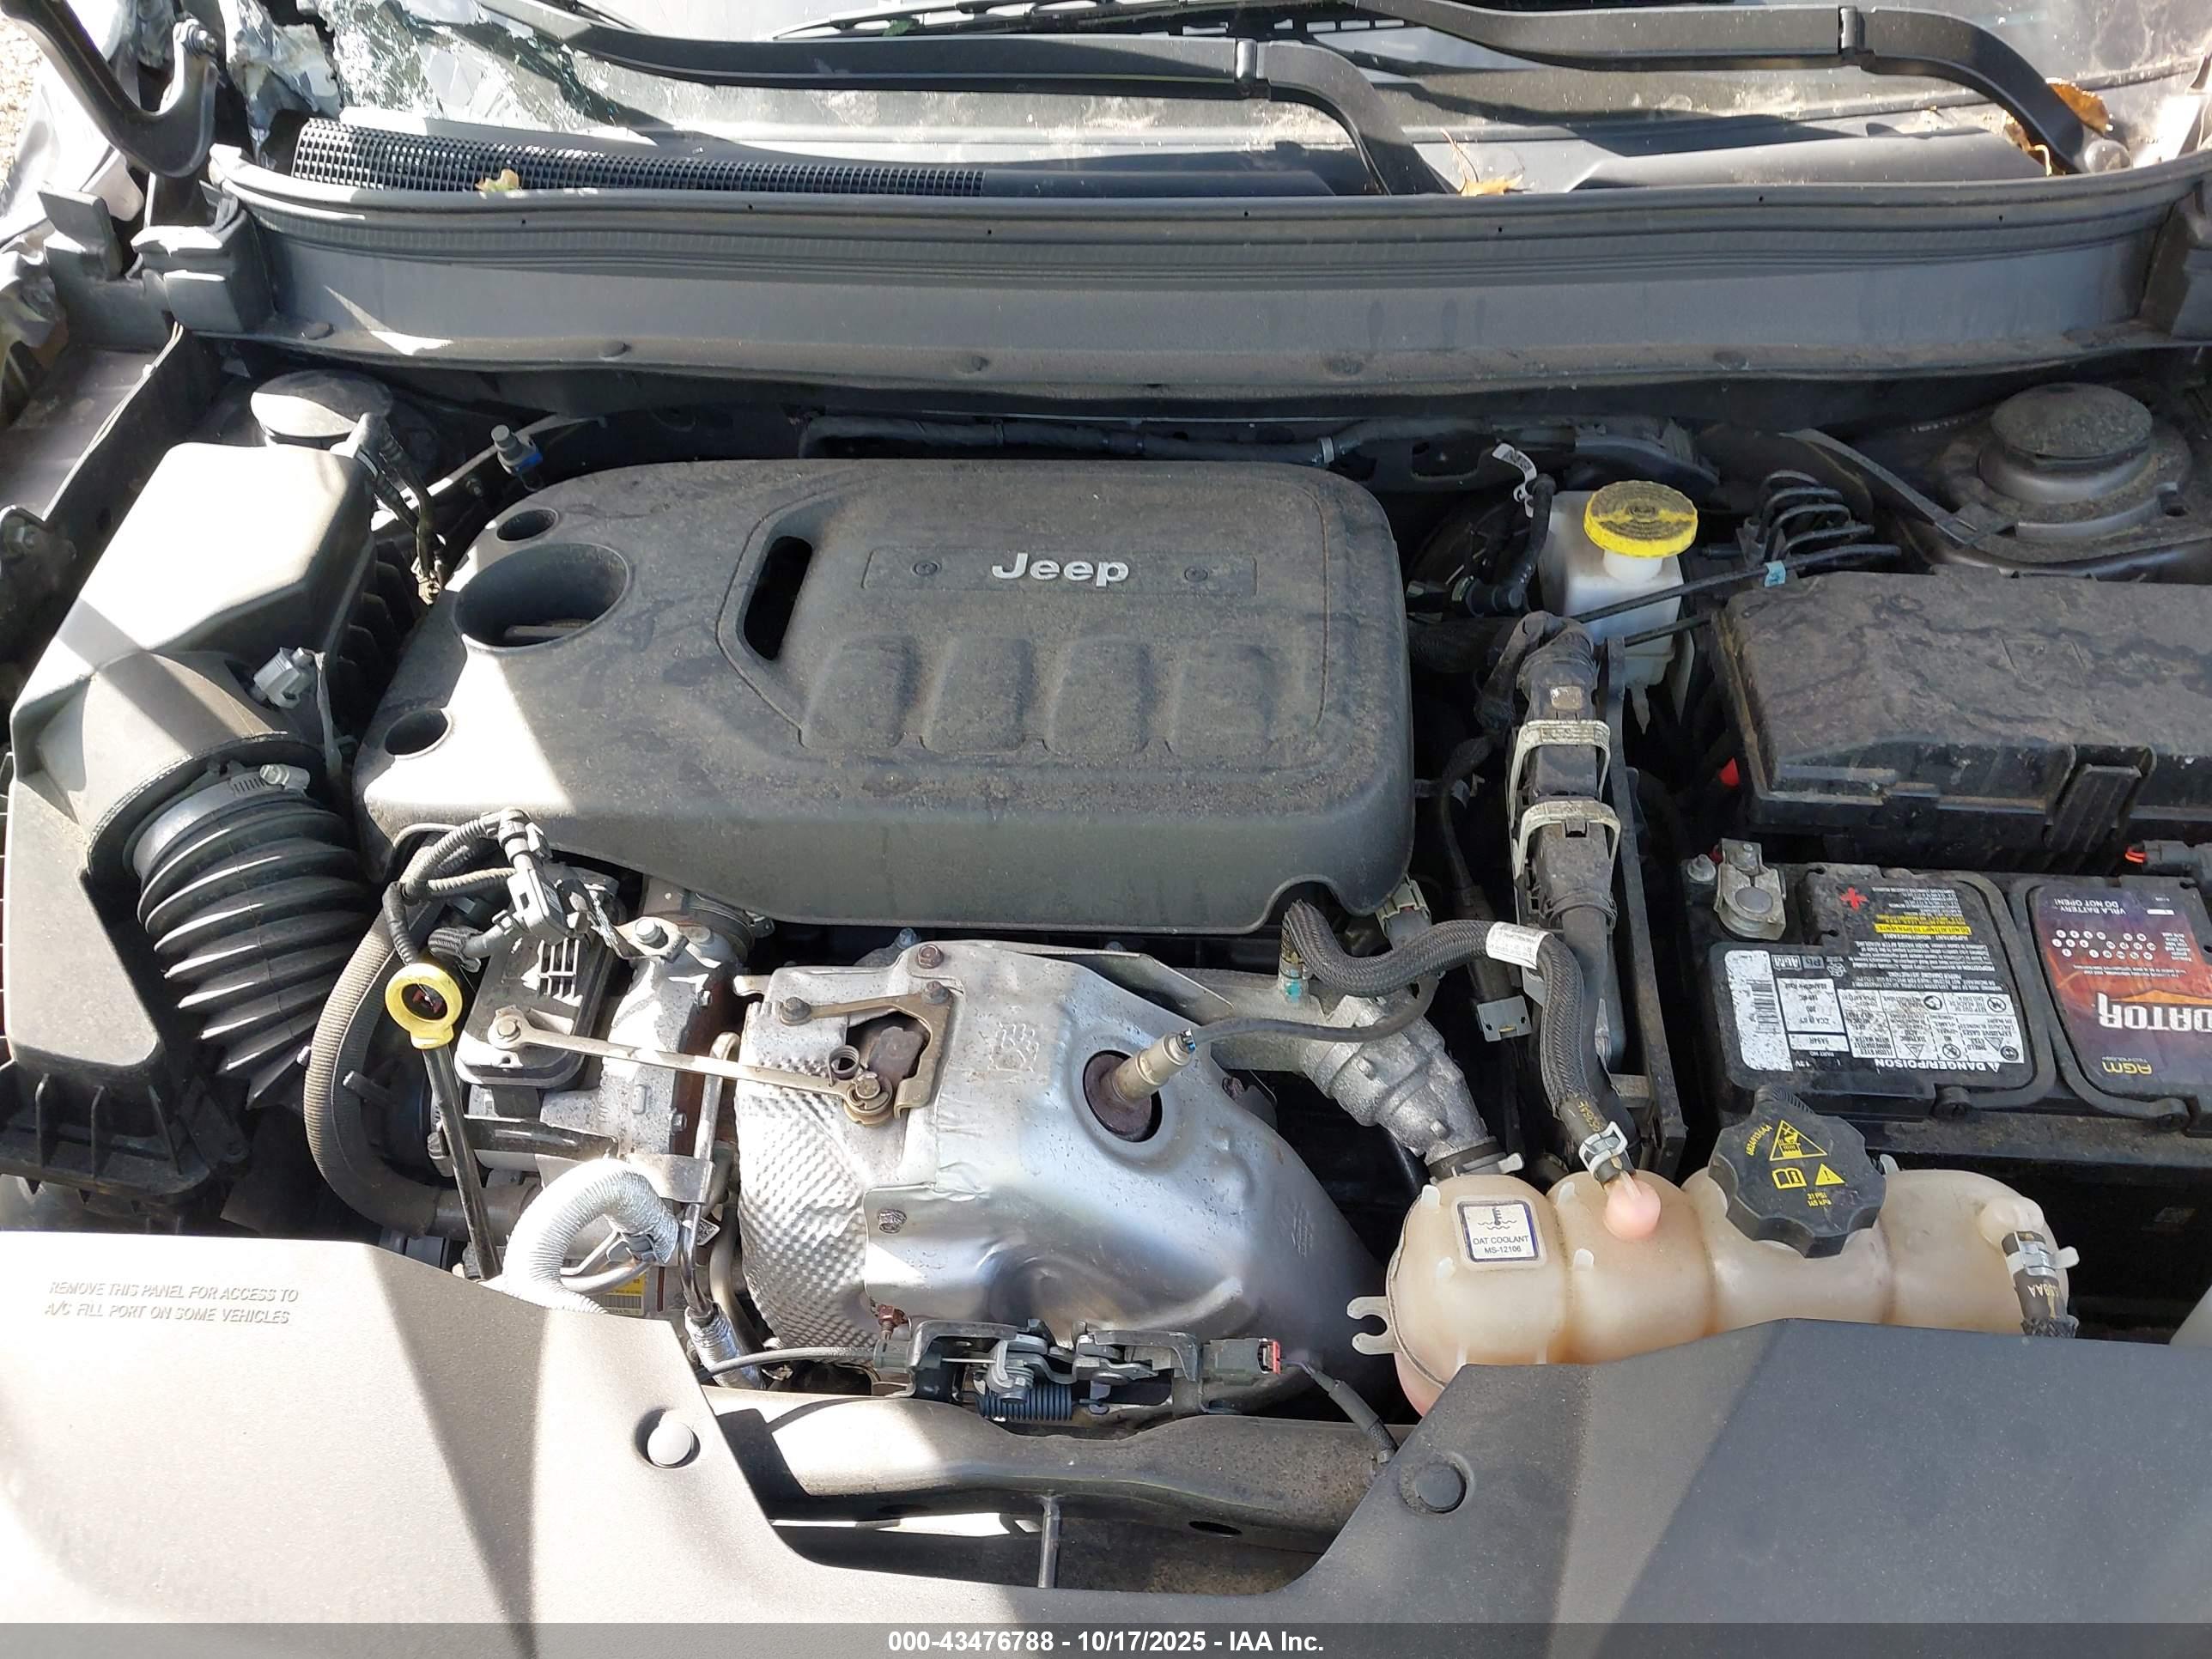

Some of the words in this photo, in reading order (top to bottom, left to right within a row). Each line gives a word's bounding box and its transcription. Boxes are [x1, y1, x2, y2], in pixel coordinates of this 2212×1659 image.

[992, 552, 1129, 588] Jeep
[2053, 898, 2082, 907] OPEN!
[2059, 905, 2100, 914] BATTERY
[1874, 1058, 1987, 1072] DANGER/POISON
[2101, 1060, 2153, 1075] AGM
[1473, 1237, 1489, 1246] OAT
[1491, 1235, 1529, 1244] COOLANT
[1484, 1245, 1522, 1255] MS-12106
[49, 1281, 105, 1295] REMOVE
[108, 1283, 139, 1297] THIS
[141, 1285, 185, 1298] PANEL
[188, 1286, 217, 1300] FOR
[219, 1286, 277, 1302] ACCESS
[280, 1288, 299, 1302] TO
[45, 1300, 73, 1316] A/C
[76, 1304, 104, 1317] FILL
[109, 1304, 147, 1318] PORT
[150, 1305, 173, 1320] ON
[175, 1306, 216, 1322] SOME
[222, 1308, 291, 1324] VEHICLES
